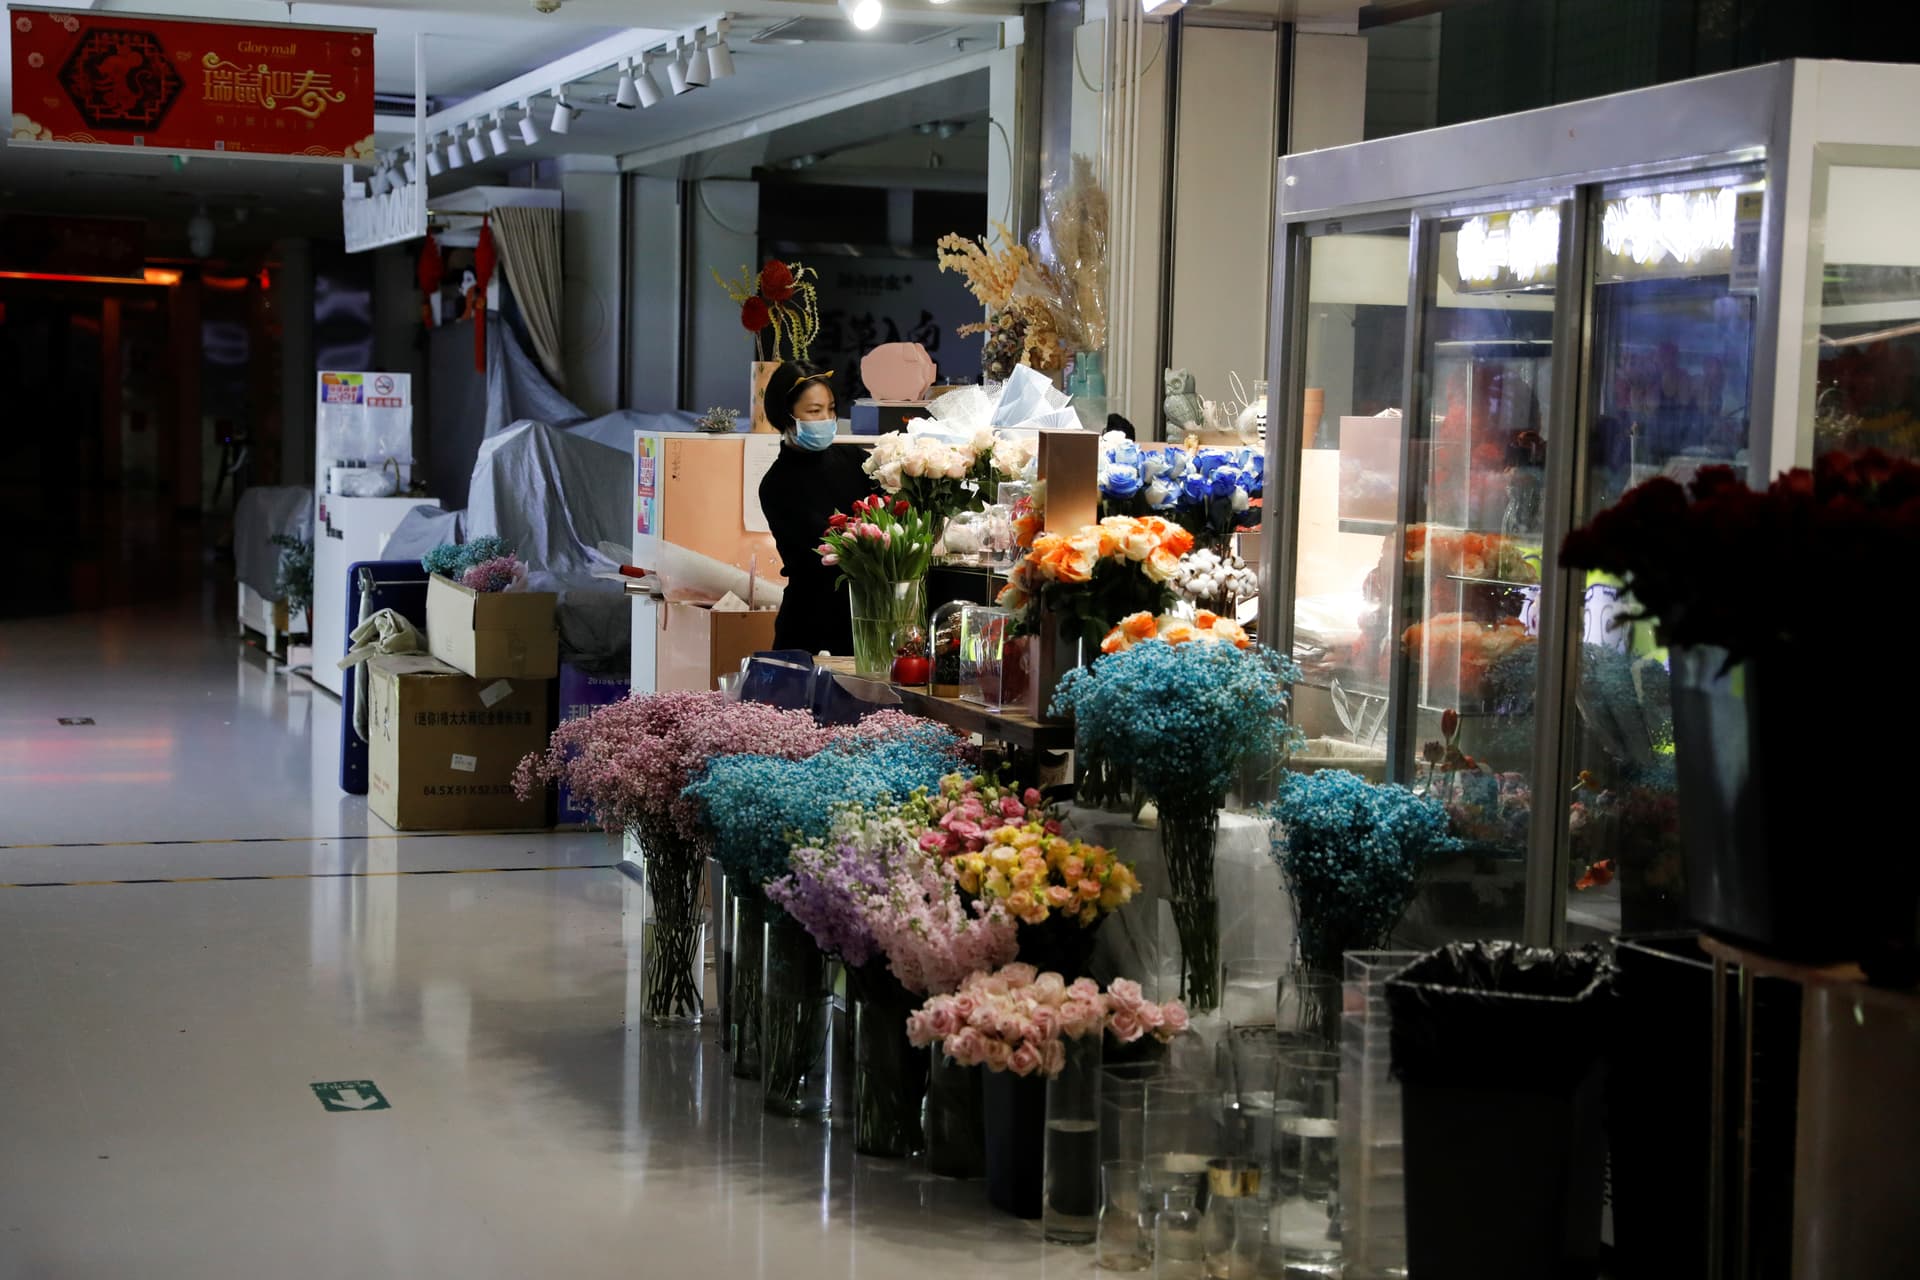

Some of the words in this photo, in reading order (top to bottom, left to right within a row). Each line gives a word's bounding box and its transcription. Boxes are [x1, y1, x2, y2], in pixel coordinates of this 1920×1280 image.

[237, 40, 269, 55] Glory
[271, 43, 297, 56] mall
[202, 51, 346, 119] 瑞鼠迎春
